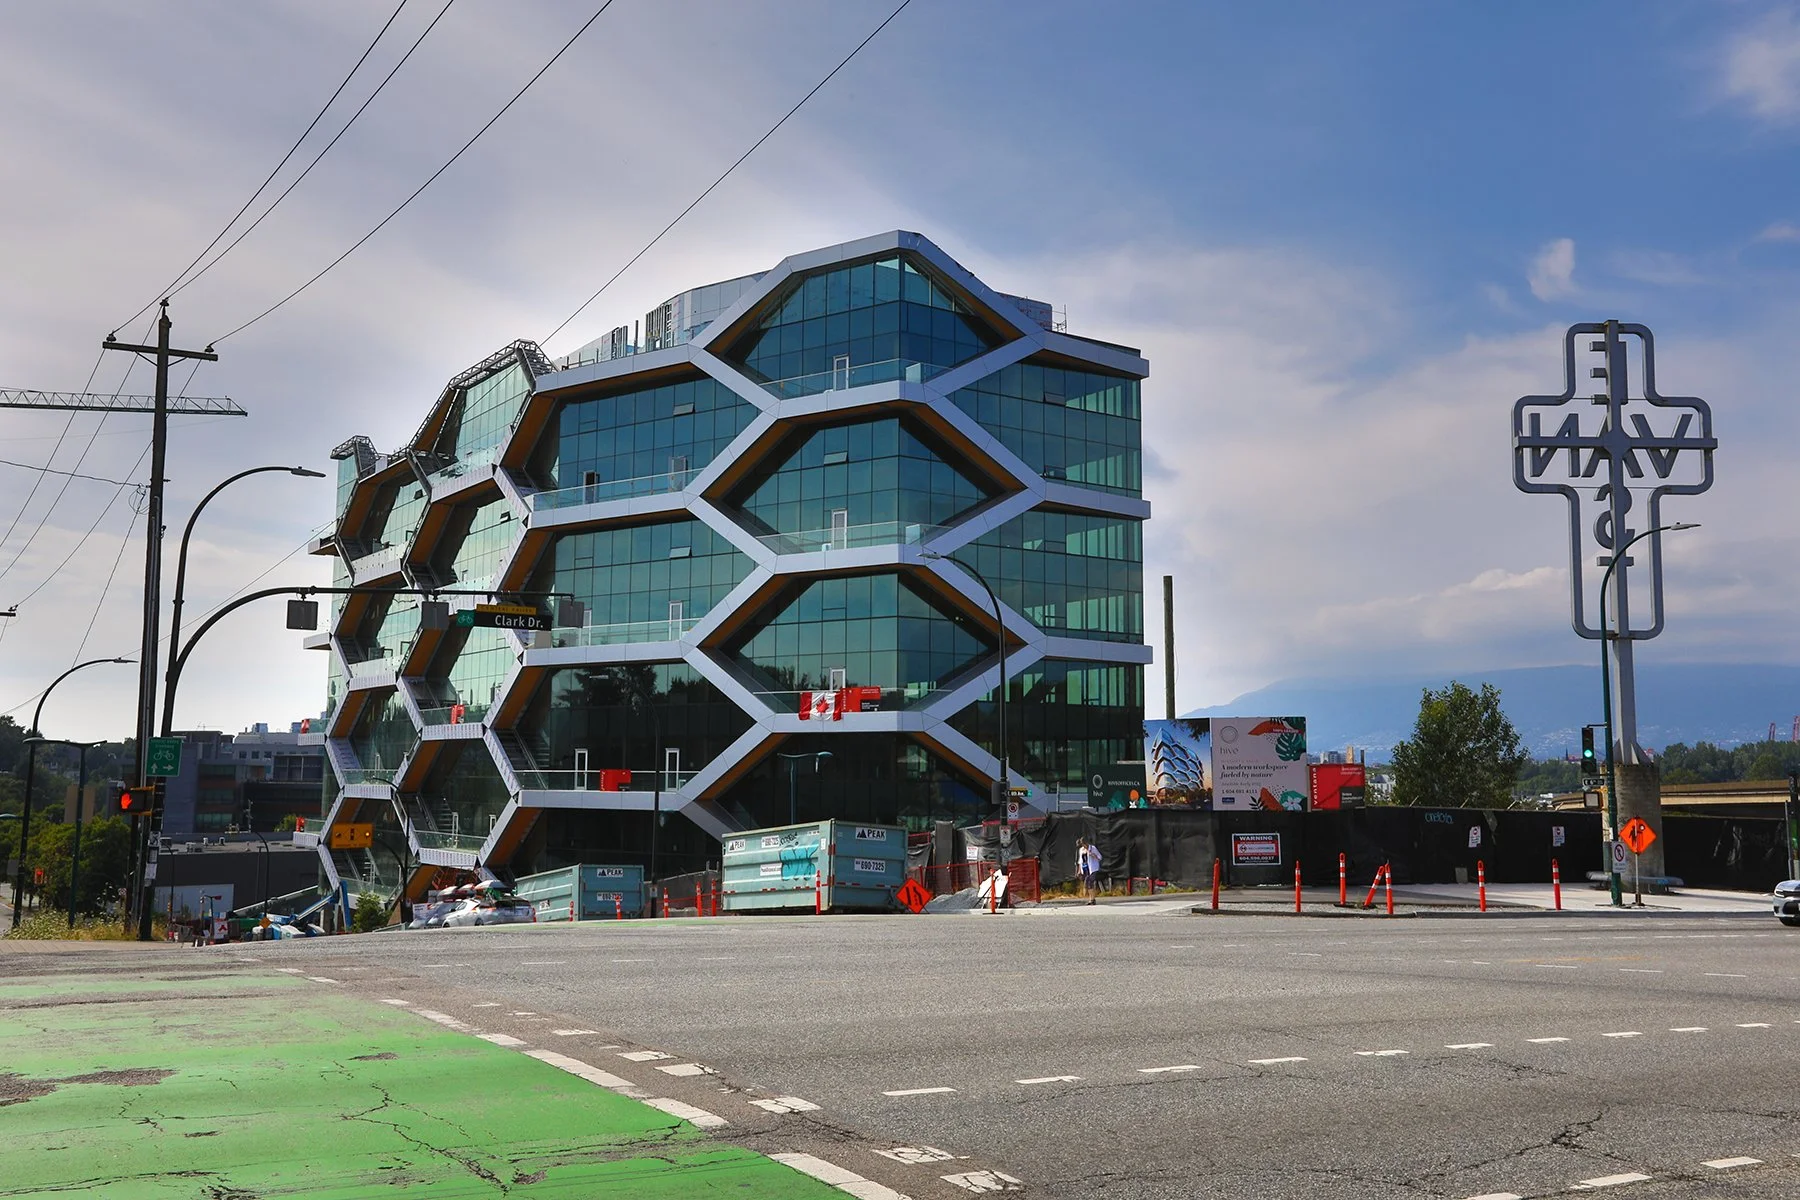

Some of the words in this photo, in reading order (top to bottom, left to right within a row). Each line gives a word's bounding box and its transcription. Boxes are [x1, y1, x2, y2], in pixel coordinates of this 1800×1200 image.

[495, 614, 525, 627] Clark
[528, 617, 544, 628] Dr.
[1219, 747, 1239, 755] hive
[1220, 771, 1241, 779] fueled
[867, 829, 885, 839] PEAK
[734, 840, 745, 849] PEAK
[861, 861, 885, 871] 690-7325
[607, 868, 623, 877] PEAK
